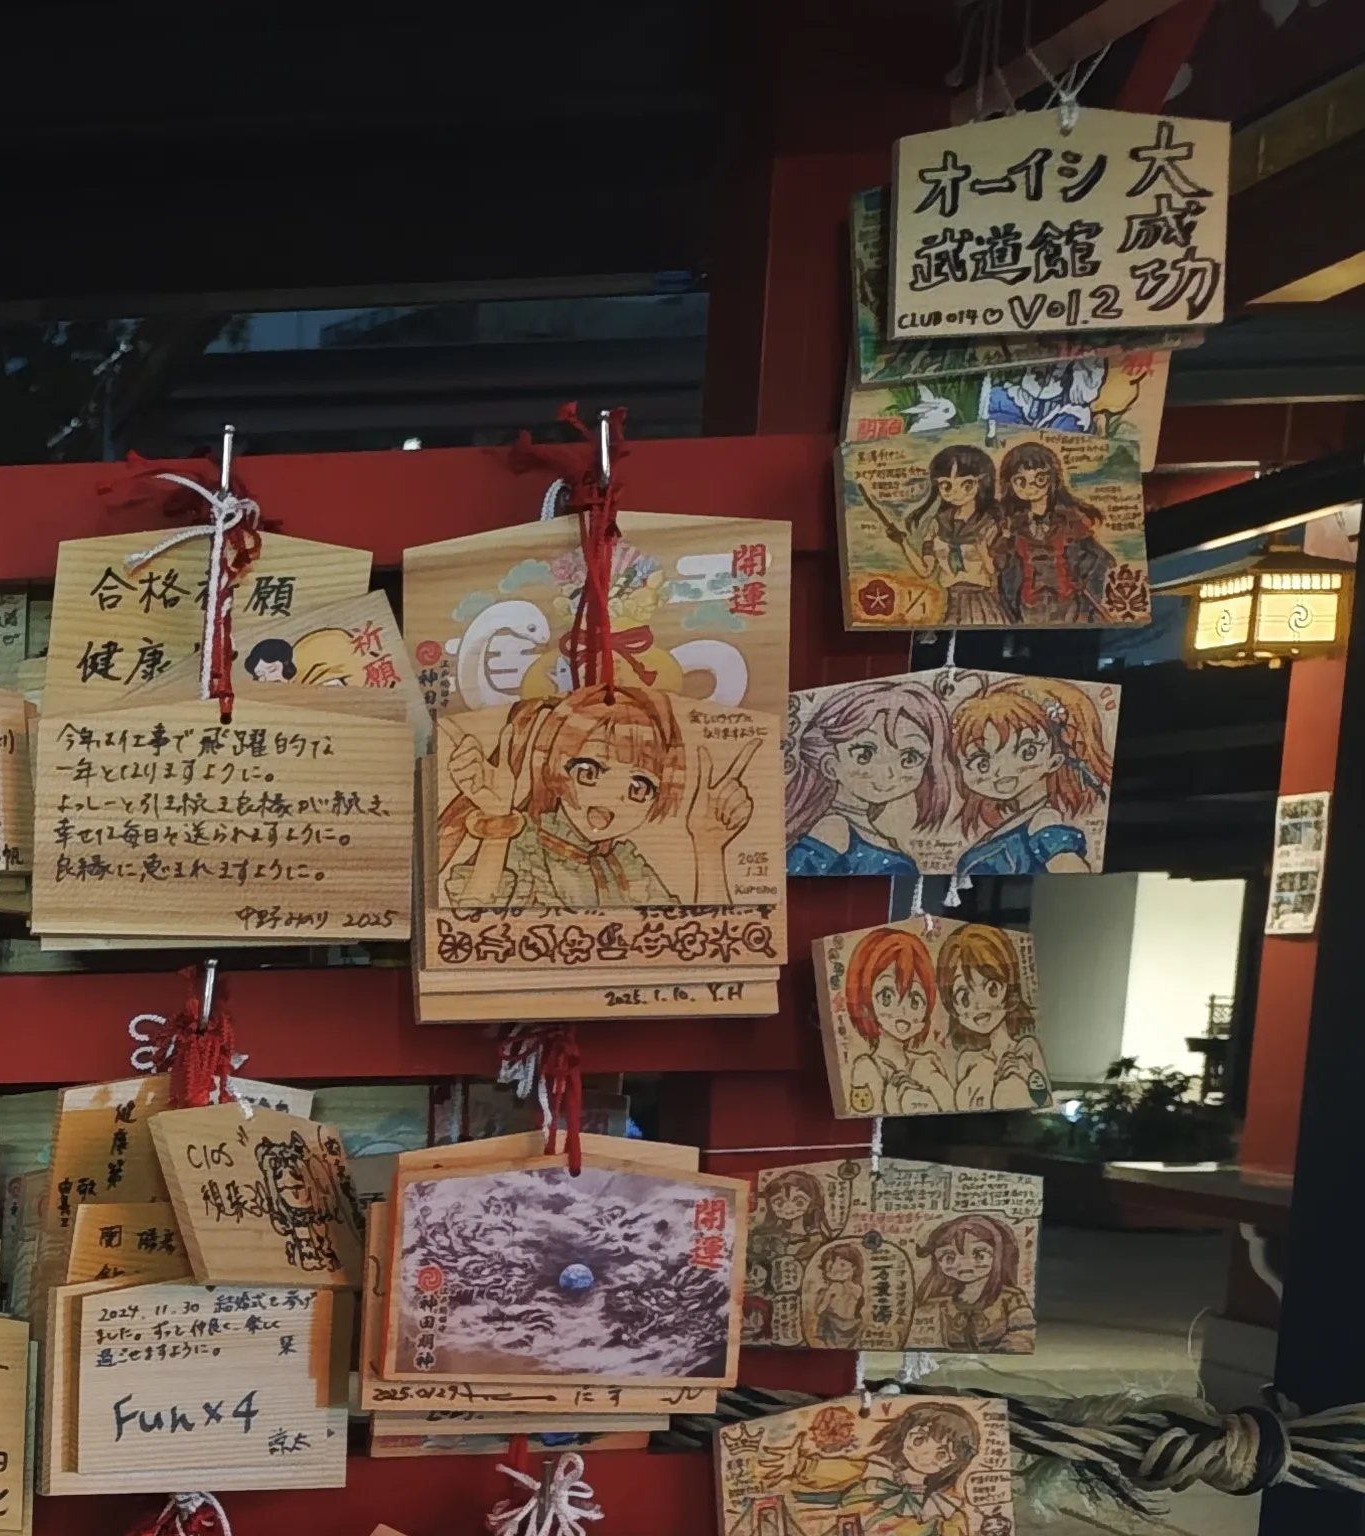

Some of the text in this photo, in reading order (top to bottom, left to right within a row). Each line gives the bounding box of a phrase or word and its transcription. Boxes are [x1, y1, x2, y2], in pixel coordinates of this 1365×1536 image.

[909, 219, 1105, 292] 武道館
[89, 566, 297, 617] 合格願
